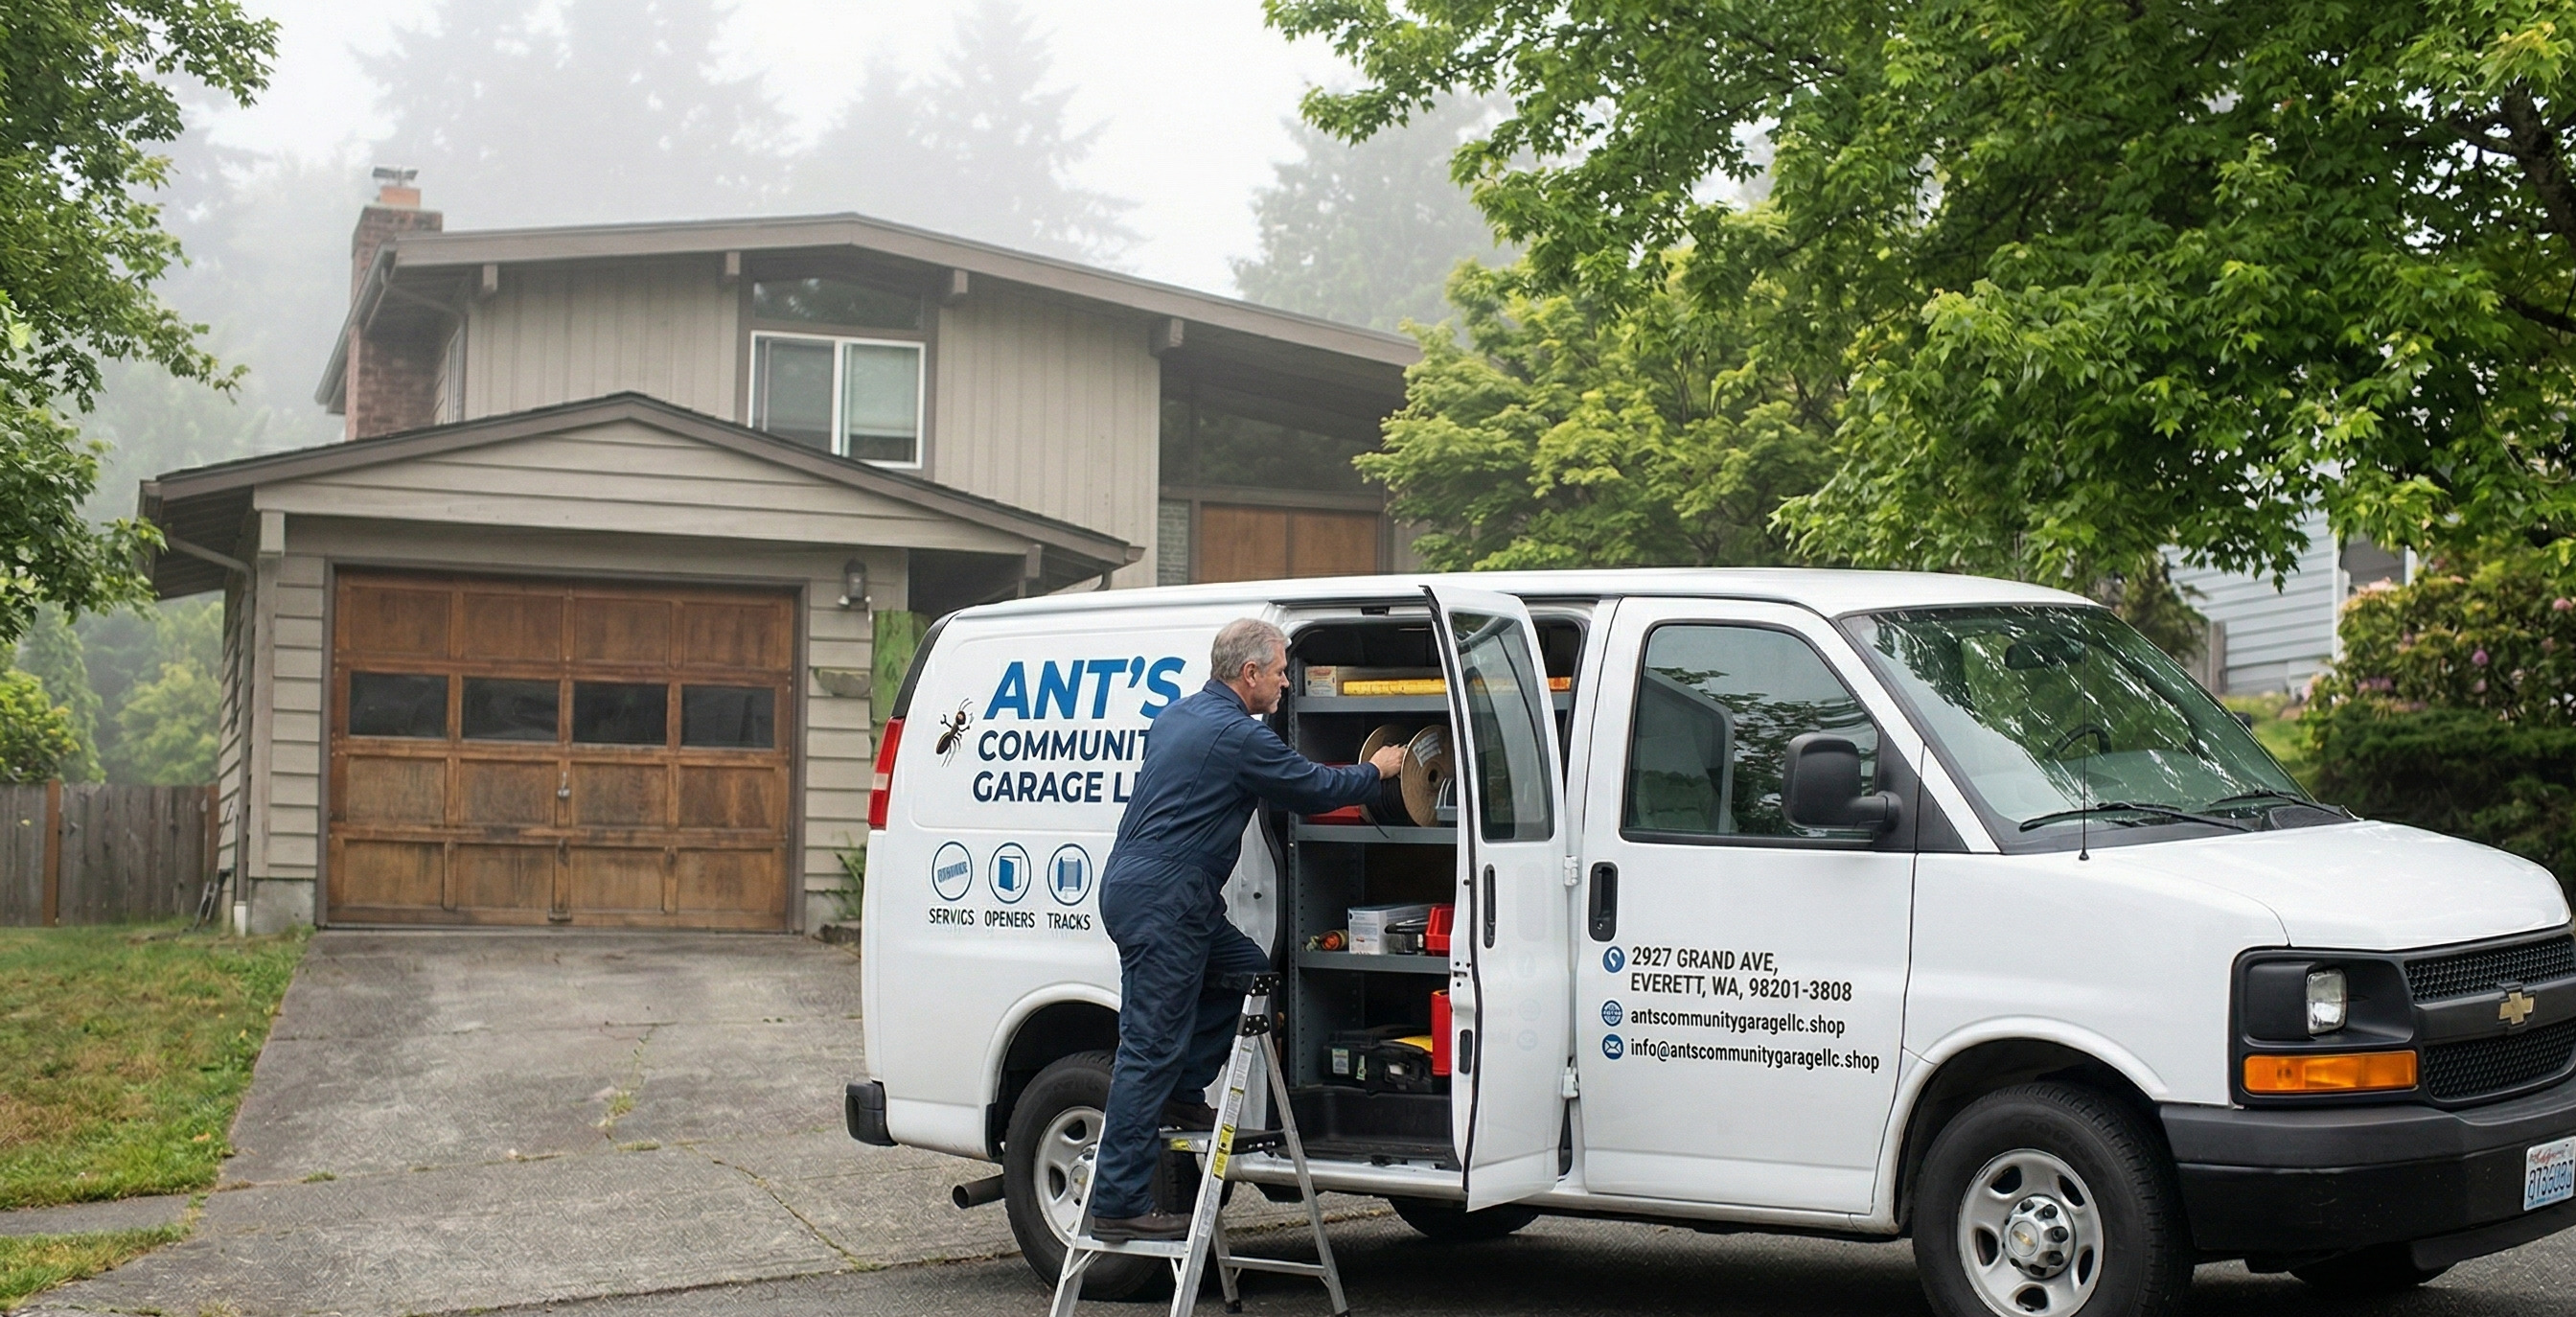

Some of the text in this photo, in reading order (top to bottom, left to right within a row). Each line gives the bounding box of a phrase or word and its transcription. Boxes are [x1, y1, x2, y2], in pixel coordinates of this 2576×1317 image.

[983, 656, 1186, 720] ANT'S
[978, 729, 1151, 762] COMMUNIT
[973, 771, 1104, 803] GARAGE
[984, 910, 1035, 929] OPENERS
[1046, 913, 1091, 931] TRACKS
[1631, 946, 1779, 977] 2927 GRAND AVE,
[1630, 972, 1852, 1002] EVERETT, WA, 98201-3808
[1630, 1007, 1846, 1039] antscommunitygaragellc.shop
[1630, 1037, 1880, 1074] info@antscommunitygaragellc.shop
